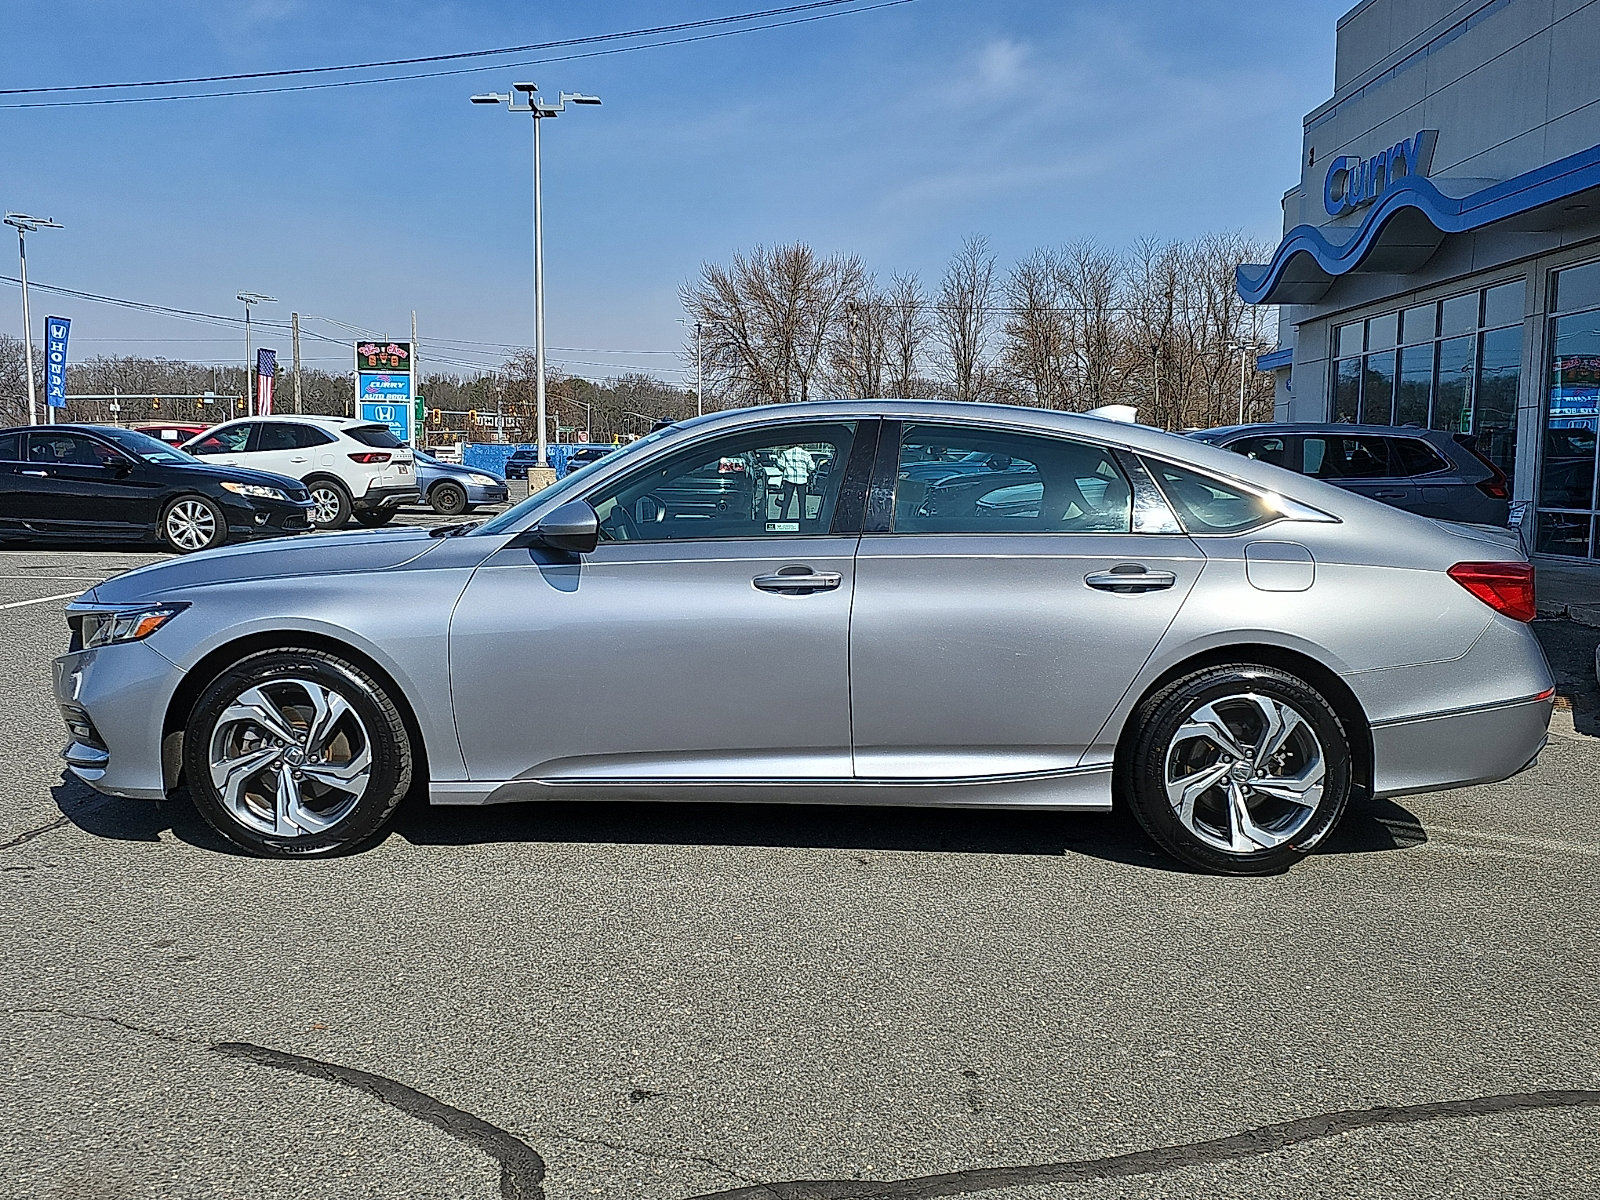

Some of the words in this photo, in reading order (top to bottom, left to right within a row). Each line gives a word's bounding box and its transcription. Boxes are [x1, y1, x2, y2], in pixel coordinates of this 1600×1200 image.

[1324, 130, 1437, 214] Curry
[50, 341, 64, 398] HONDA
[369, 381, 405, 389] CURRY
